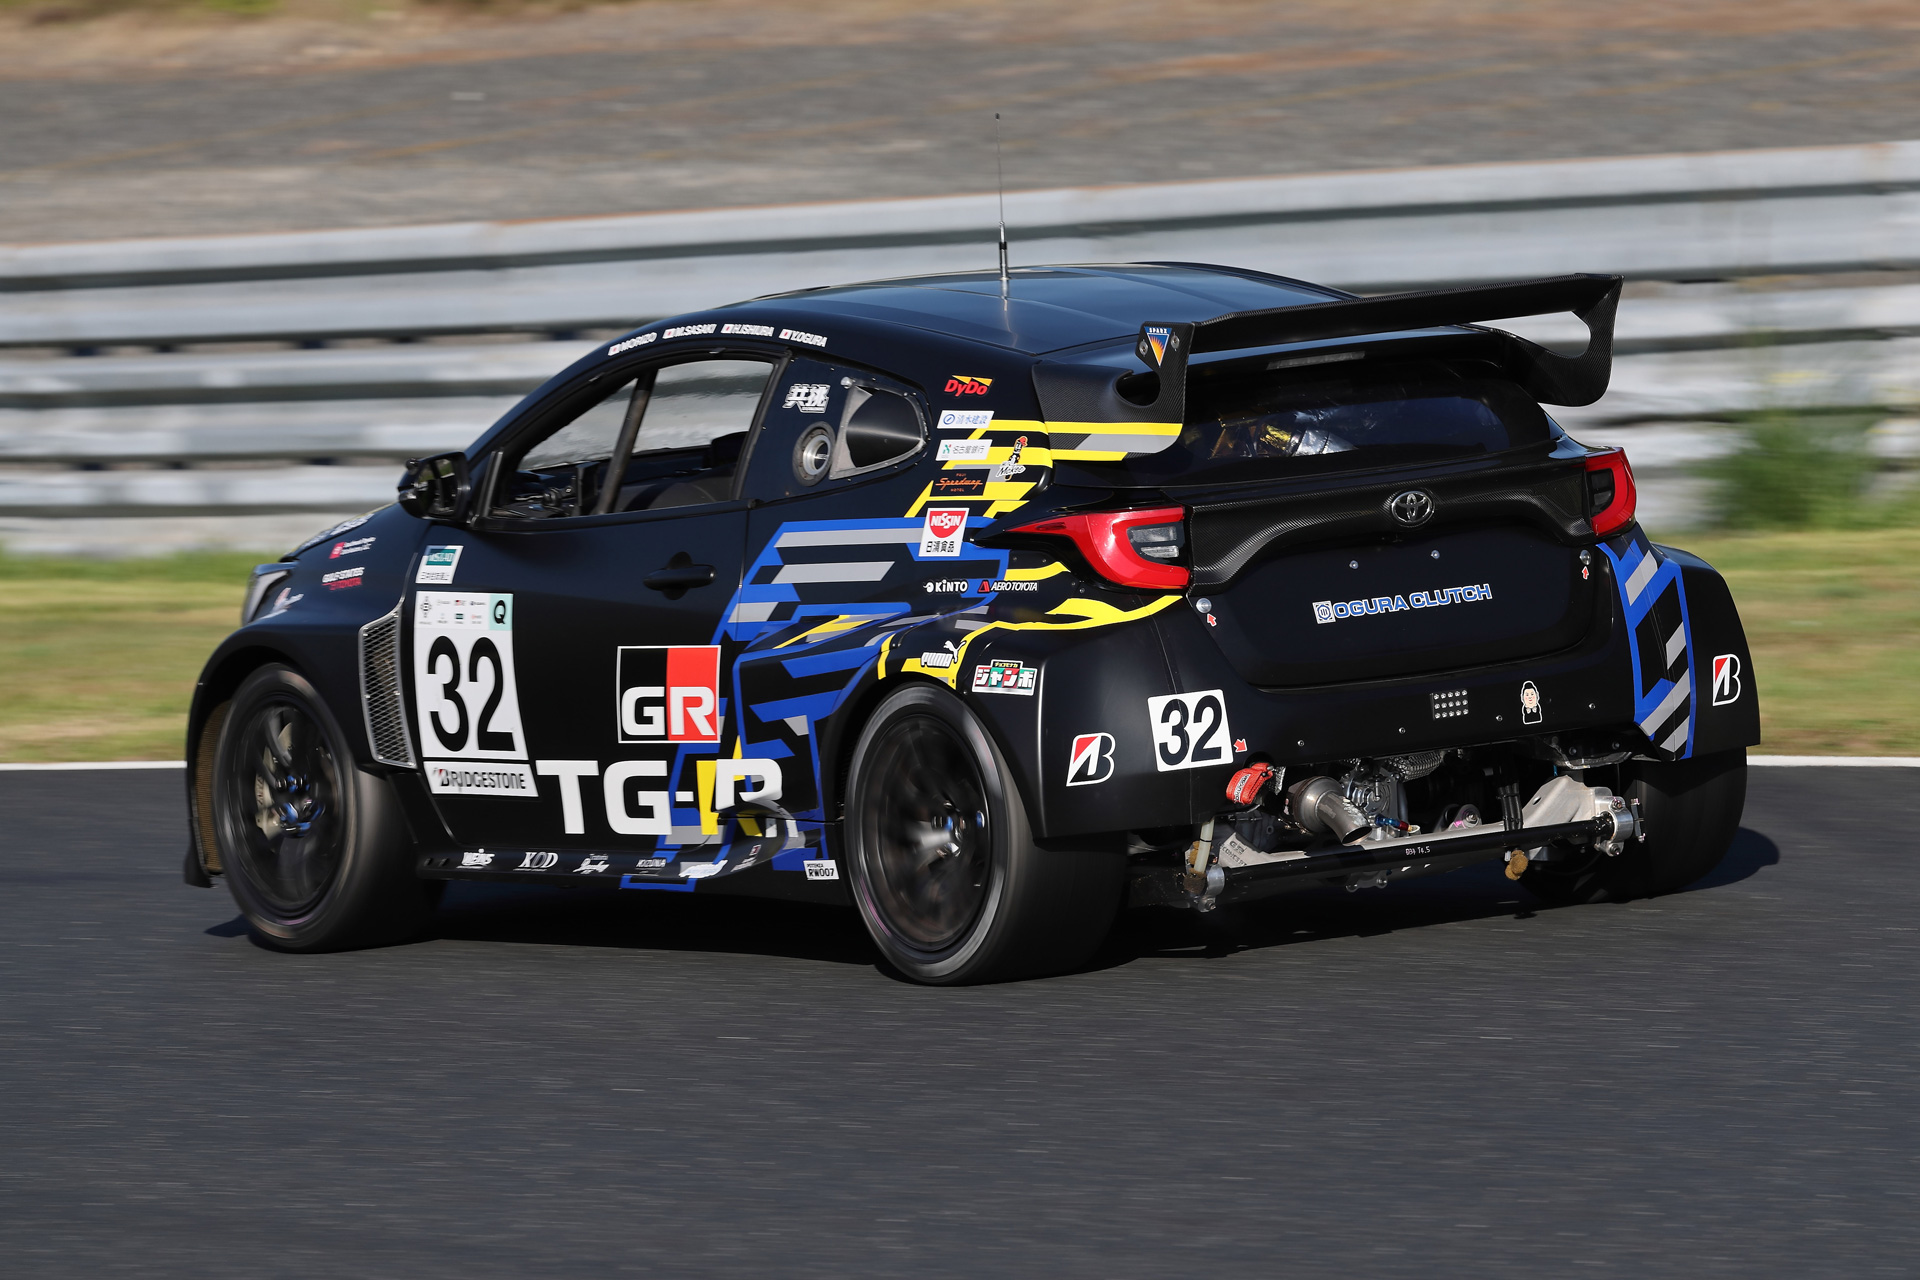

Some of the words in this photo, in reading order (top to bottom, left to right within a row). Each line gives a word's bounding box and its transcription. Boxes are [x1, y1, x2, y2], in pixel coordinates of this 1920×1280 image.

[944, 379, 988, 397] DyDo
[935, 477, 983, 490] Speedway
[931, 512, 961, 530] NISSIN
[1333, 595, 1409, 618] OGURA
[1409, 583, 1492, 608] CLUTCH
[494, 600, 505, 624] Q
[921, 652, 953, 667] PUMA
[975, 669, 1034, 687] ジャンボ
[427, 636, 516, 752] 32
[621, 686, 716, 735] GR
[1159, 695, 1222, 766] 32
[434, 769, 526, 790] BRIDGESTONE
